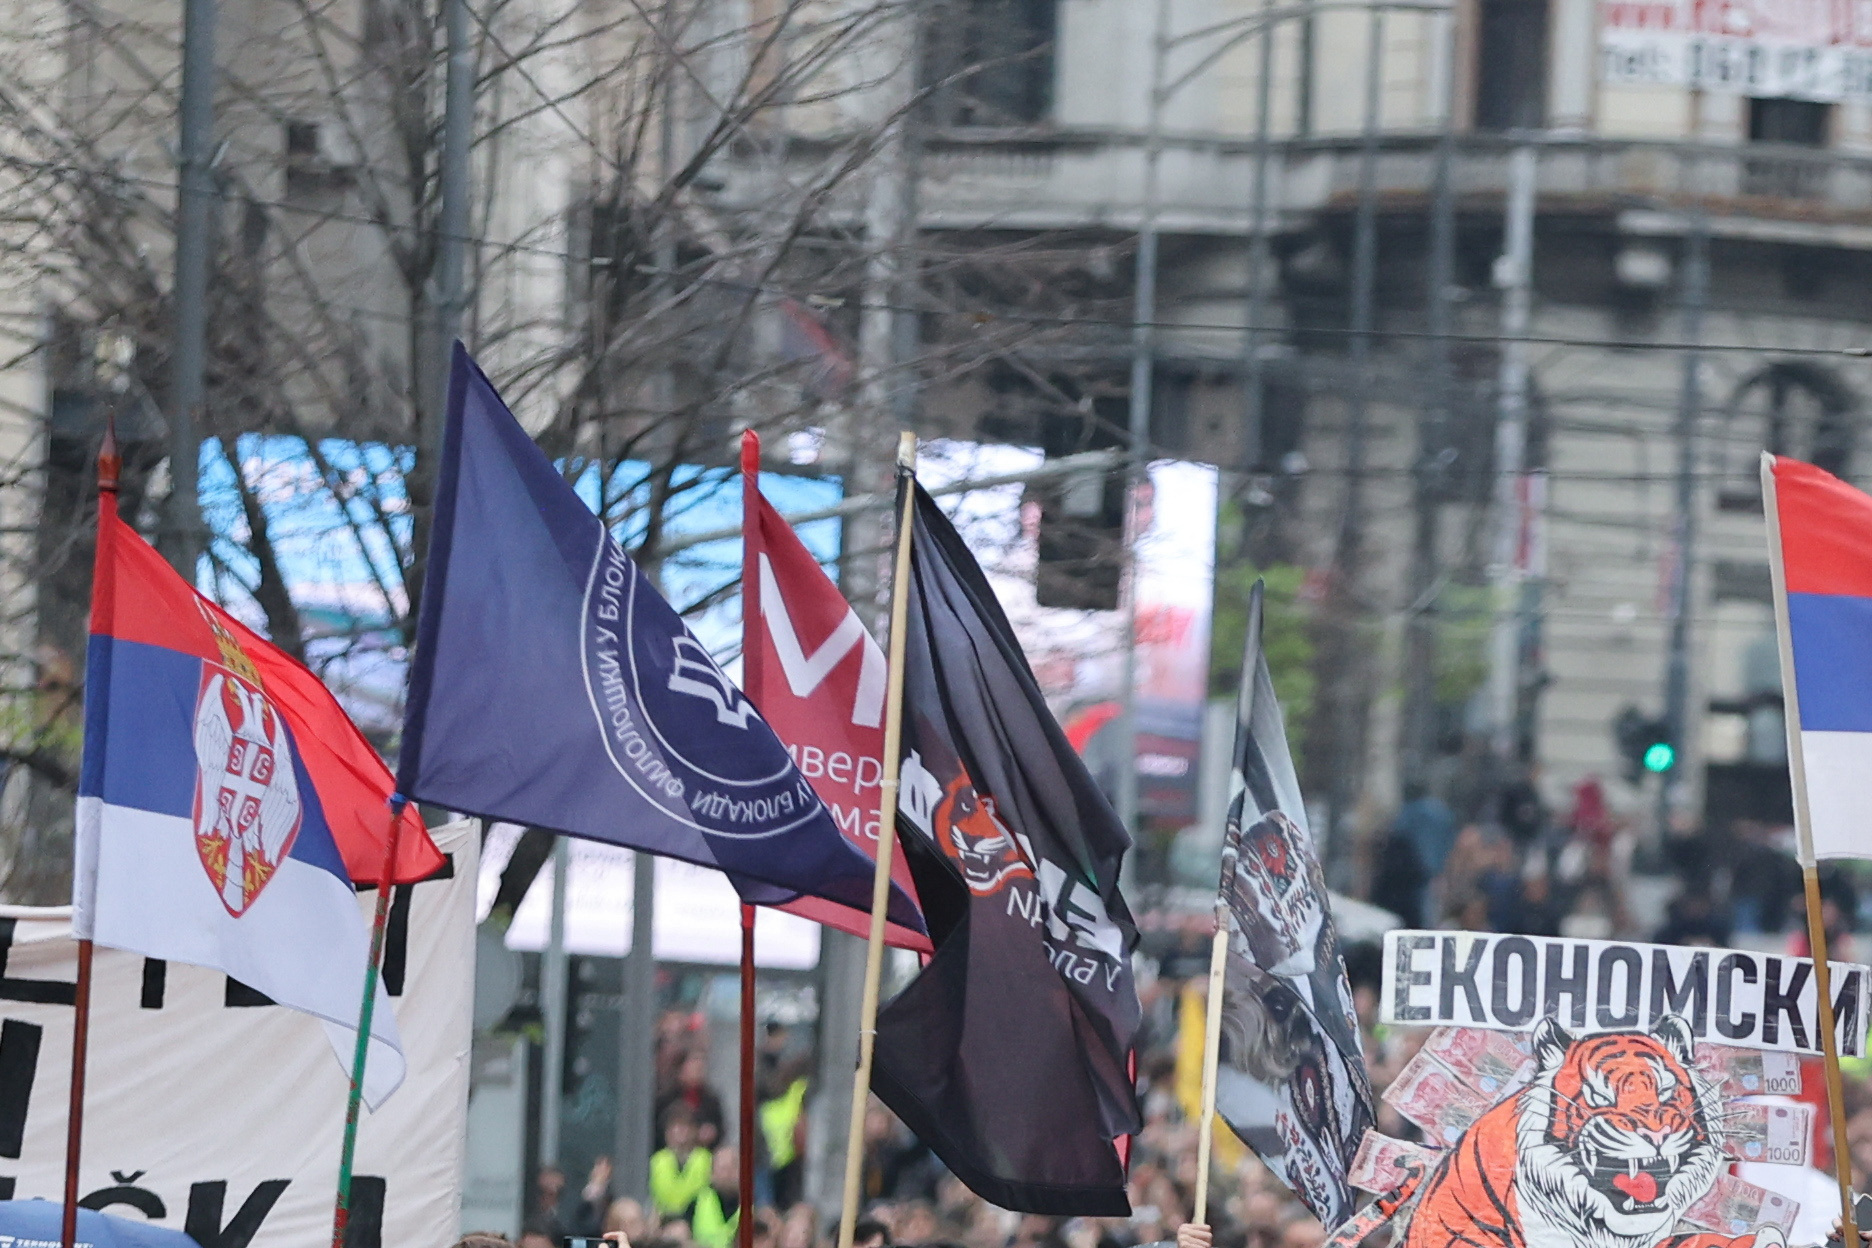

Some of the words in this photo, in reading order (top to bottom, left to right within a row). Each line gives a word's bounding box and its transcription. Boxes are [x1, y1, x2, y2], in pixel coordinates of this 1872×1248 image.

[596, 650, 685, 798] ФИЛОЛОШКИ
[691, 790, 794, 824] БЛОКАДИ
[1393, 935, 1862, 1057] ЕКОНОМСКИ
[1765, 1077, 1797, 1092] 1000
[1769, 1147, 1801, 1162] 1000
